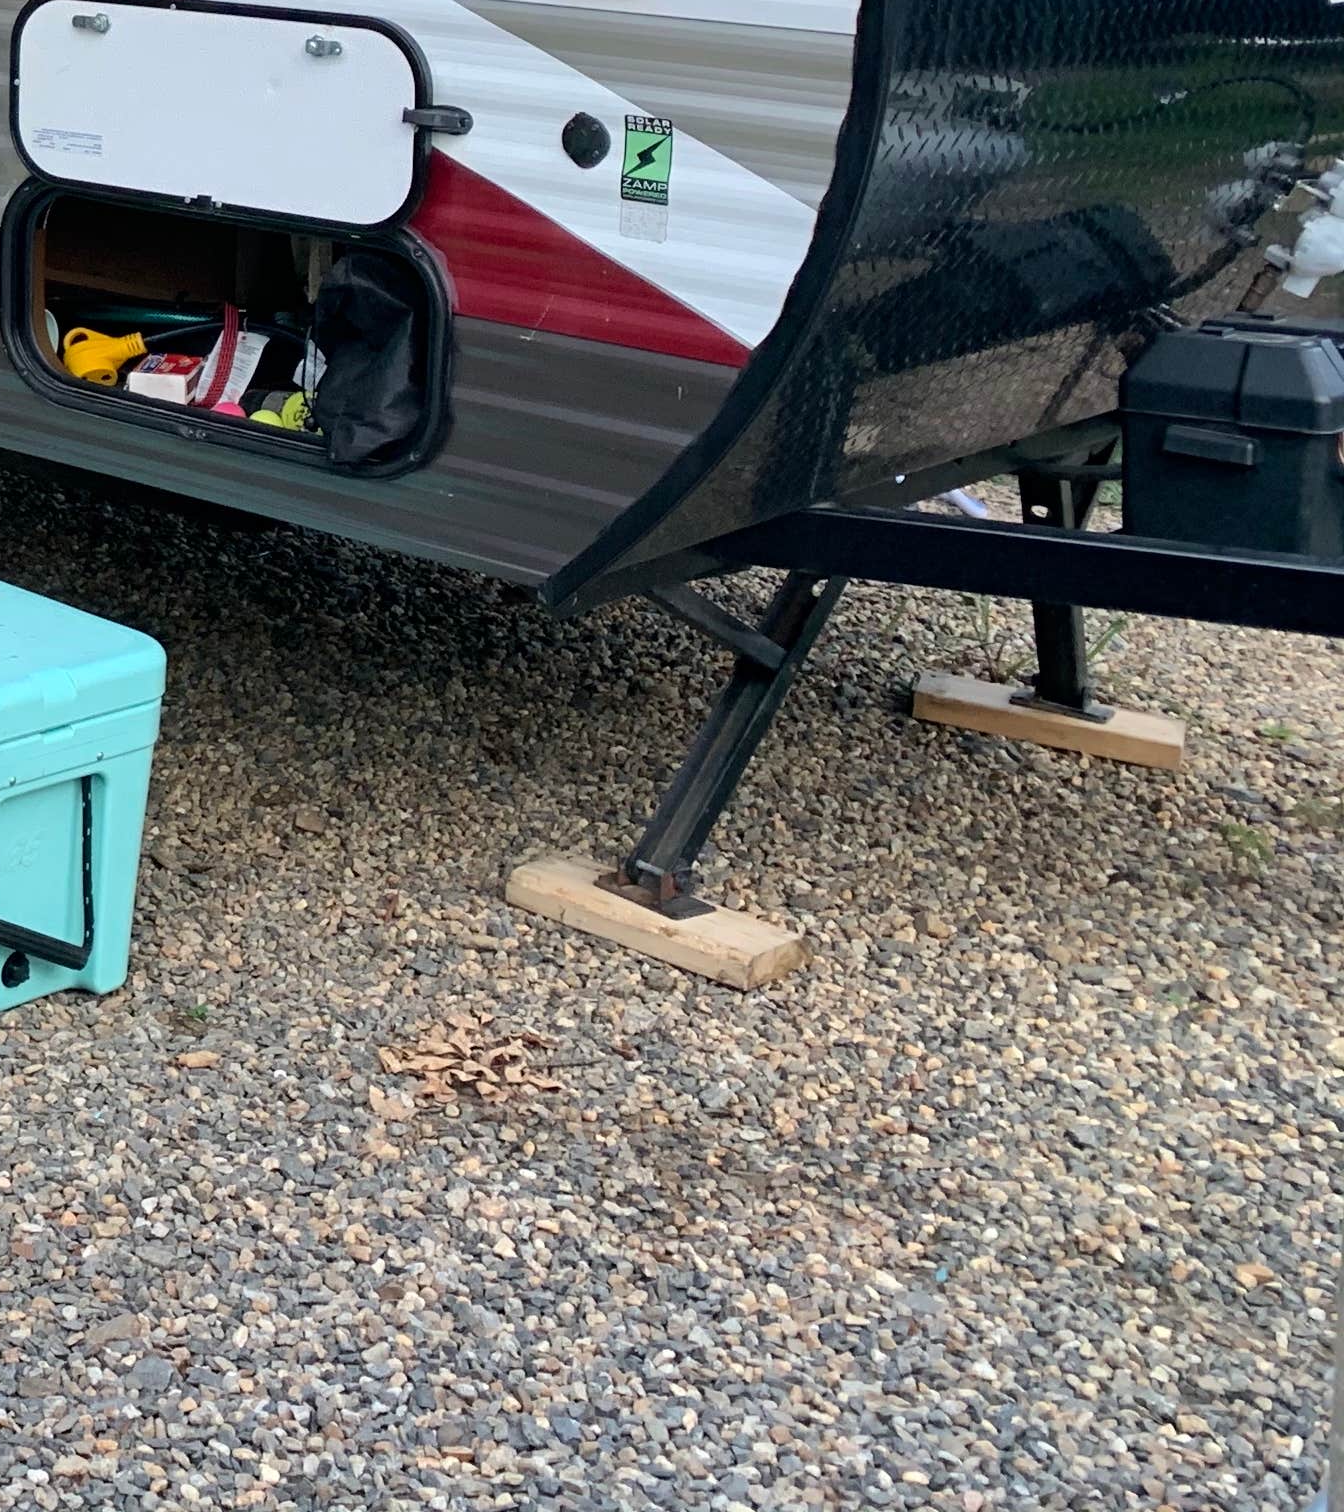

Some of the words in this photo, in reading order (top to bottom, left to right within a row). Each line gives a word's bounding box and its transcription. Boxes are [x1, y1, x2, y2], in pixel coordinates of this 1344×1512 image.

[626, 115, 670, 128] SOLAR
[627, 123, 671, 135] READY
[622, 177, 668, 192] ZAMP
